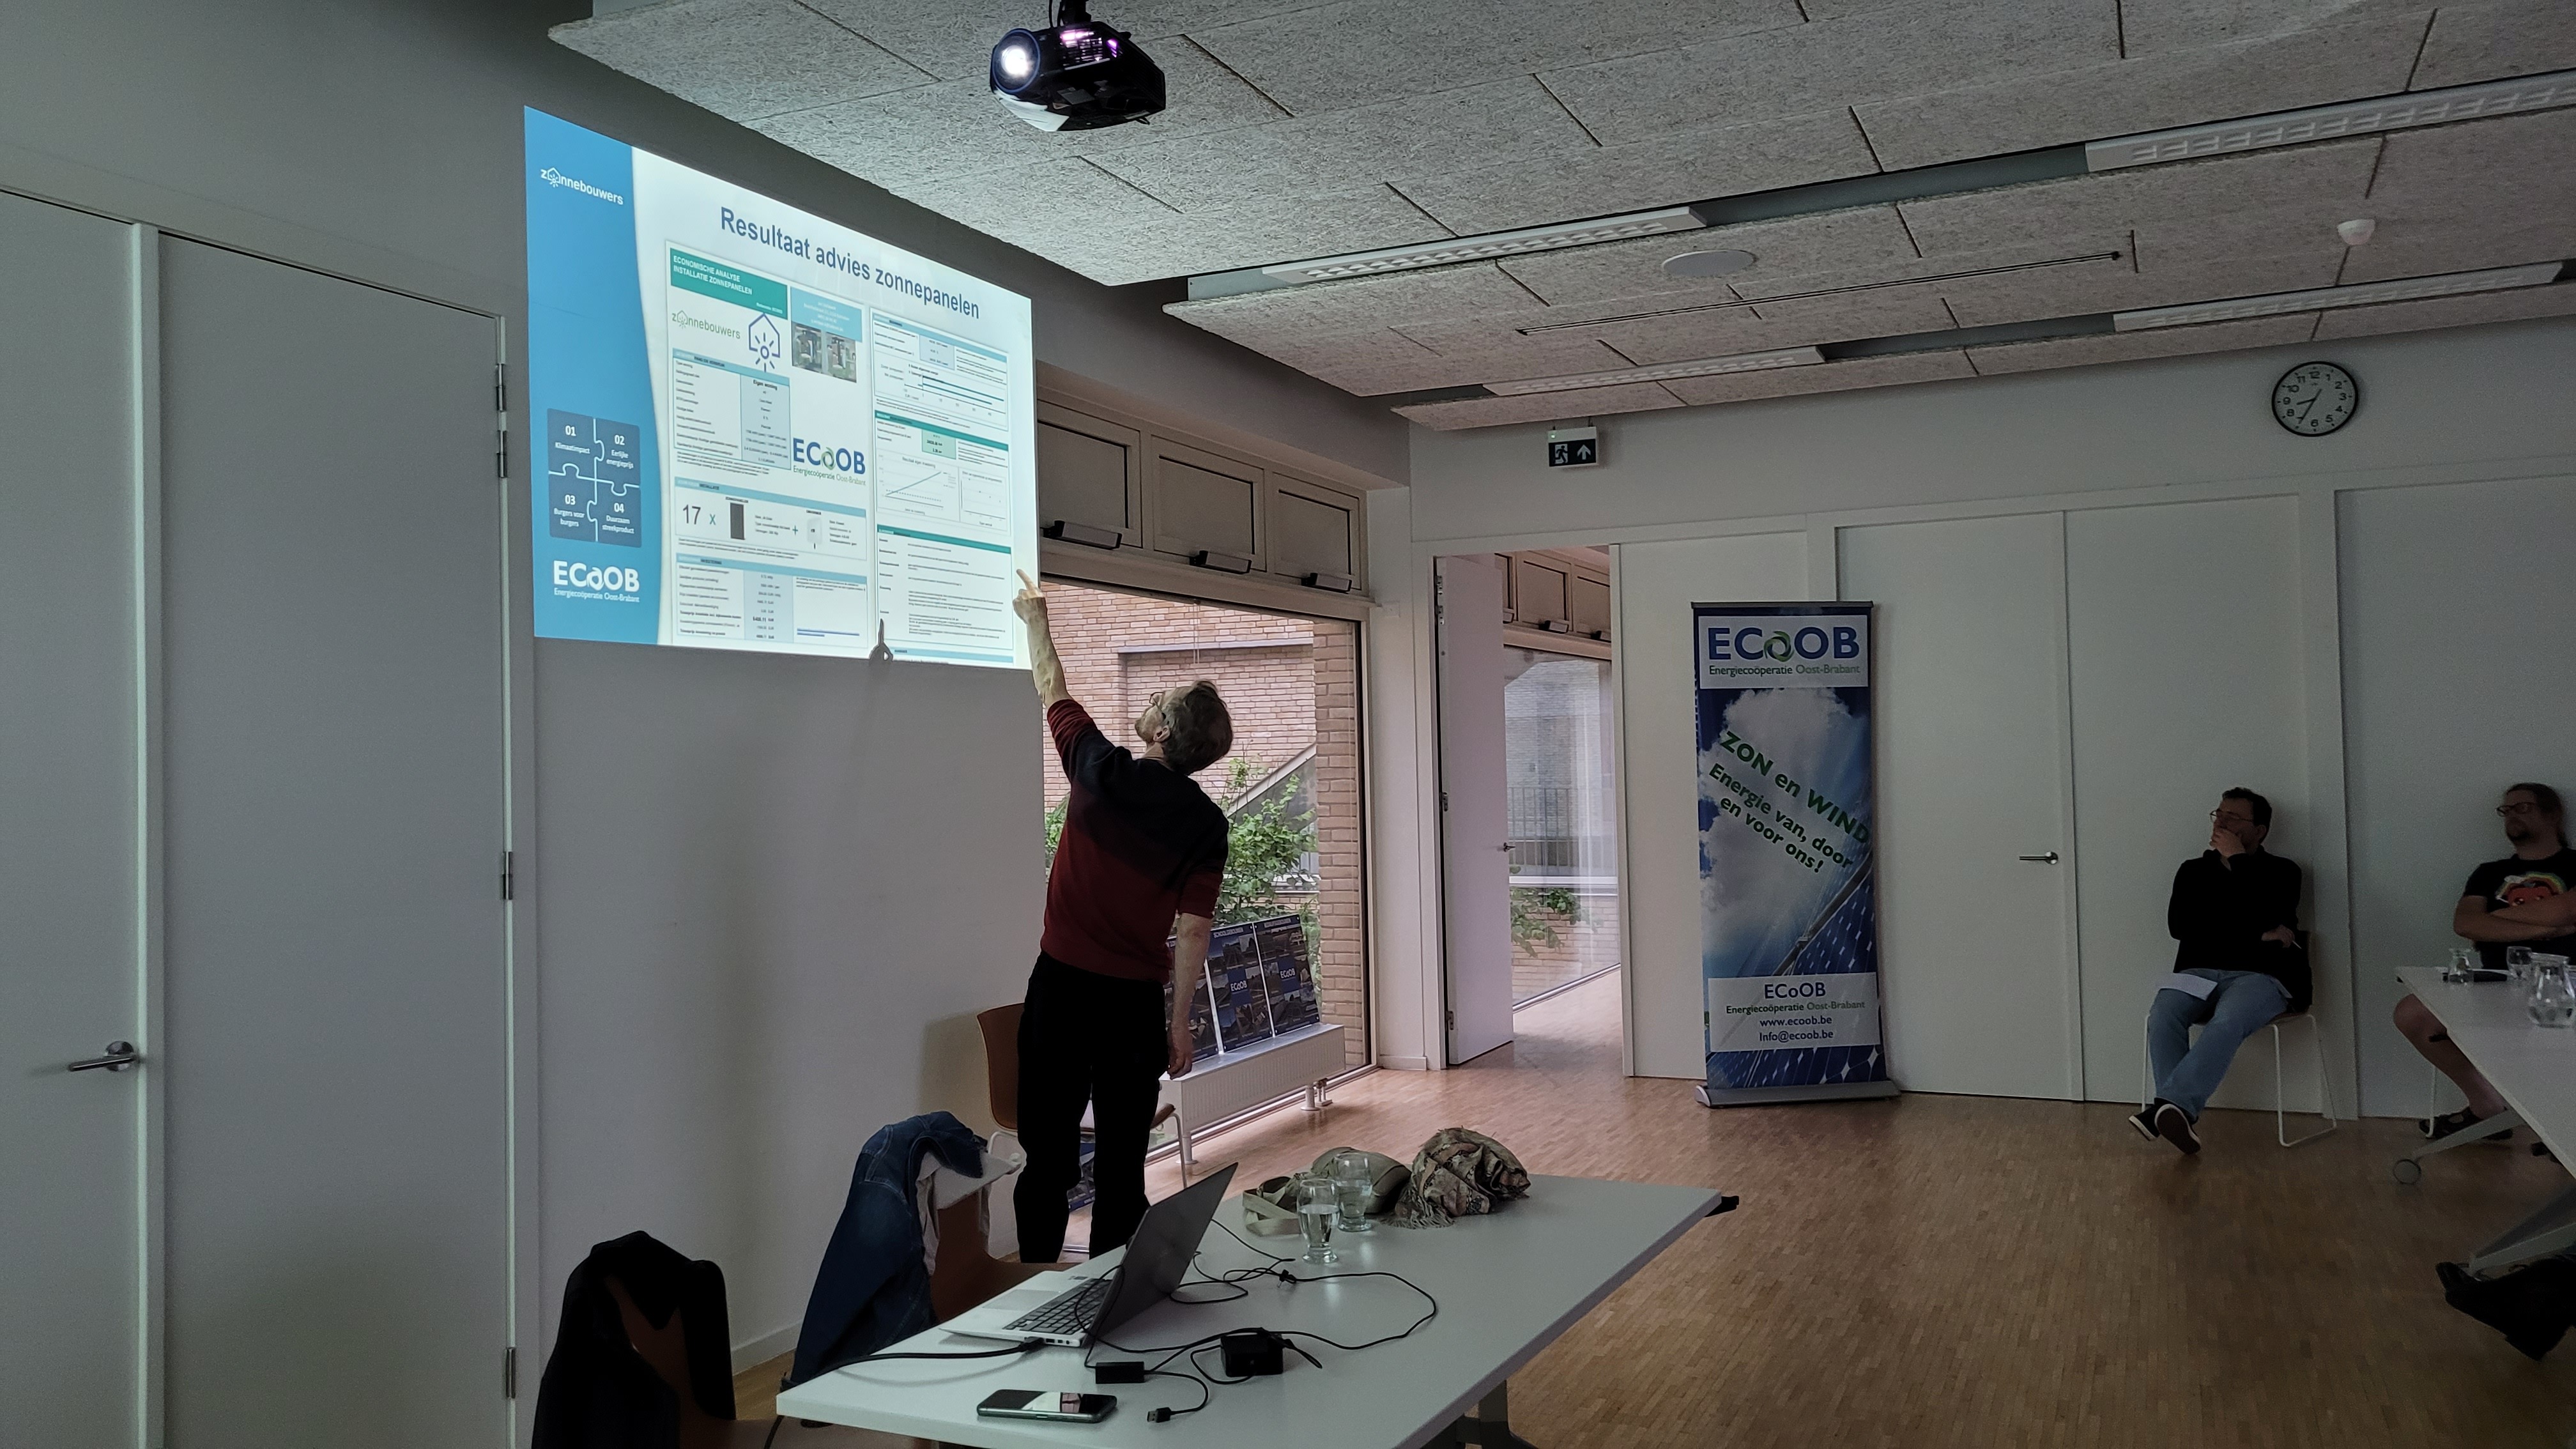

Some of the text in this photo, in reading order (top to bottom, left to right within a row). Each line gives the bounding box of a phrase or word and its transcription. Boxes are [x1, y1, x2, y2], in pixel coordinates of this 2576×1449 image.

[721, 206, 810, 260] Resultaat
[816, 247, 870, 280] advies
[875, 268, 979, 319] zonnepanelen
[673, 256, 740, 282] ECONOMISCHE ANALYSE
[673, 265, 752, 295] INSTALLATIE ZONNEPANELEN
[2308, 371, 2320, 379] 12
[2283, 397, 2291, 405] 9
[565, 425, 576, 436] 01
[614, 434, 625, 445] 02
[555, 441, 590, 454] Klimaatimpact
[611, 449, 629, 459] Eerlijke
[606, 459, 634, 469] energieprijs
[565, 494, 575, 505] 03
[554, 508, 572, 517] Burgers
[614, 503, 624, 513] 04
[606, 515, 630, 524] Duurzaam
[682, 504, 701, 525] 17
[560, 518, 579, 527] burgers
[602, 524, 634, 534] streekproduct
[1709, 664, 1860, 677] Energiecoöperatie Oost-Brabant
[1720, 730, 1869, 843] ZON en WIND
[1709, 763, 1854, 868] Energie van, door
[1721, 797, 1824, 873] en voor ons!
[1764, 982, 1826, 999] ECoOB
[1726, 1001, 1865, 1015] Energiecoöperatie Oost-Brabant
[1759, 1015, 1832, 1027] www.ecoob.be
[1759, 1030, 1834, 1043] Info@ecoob.be
